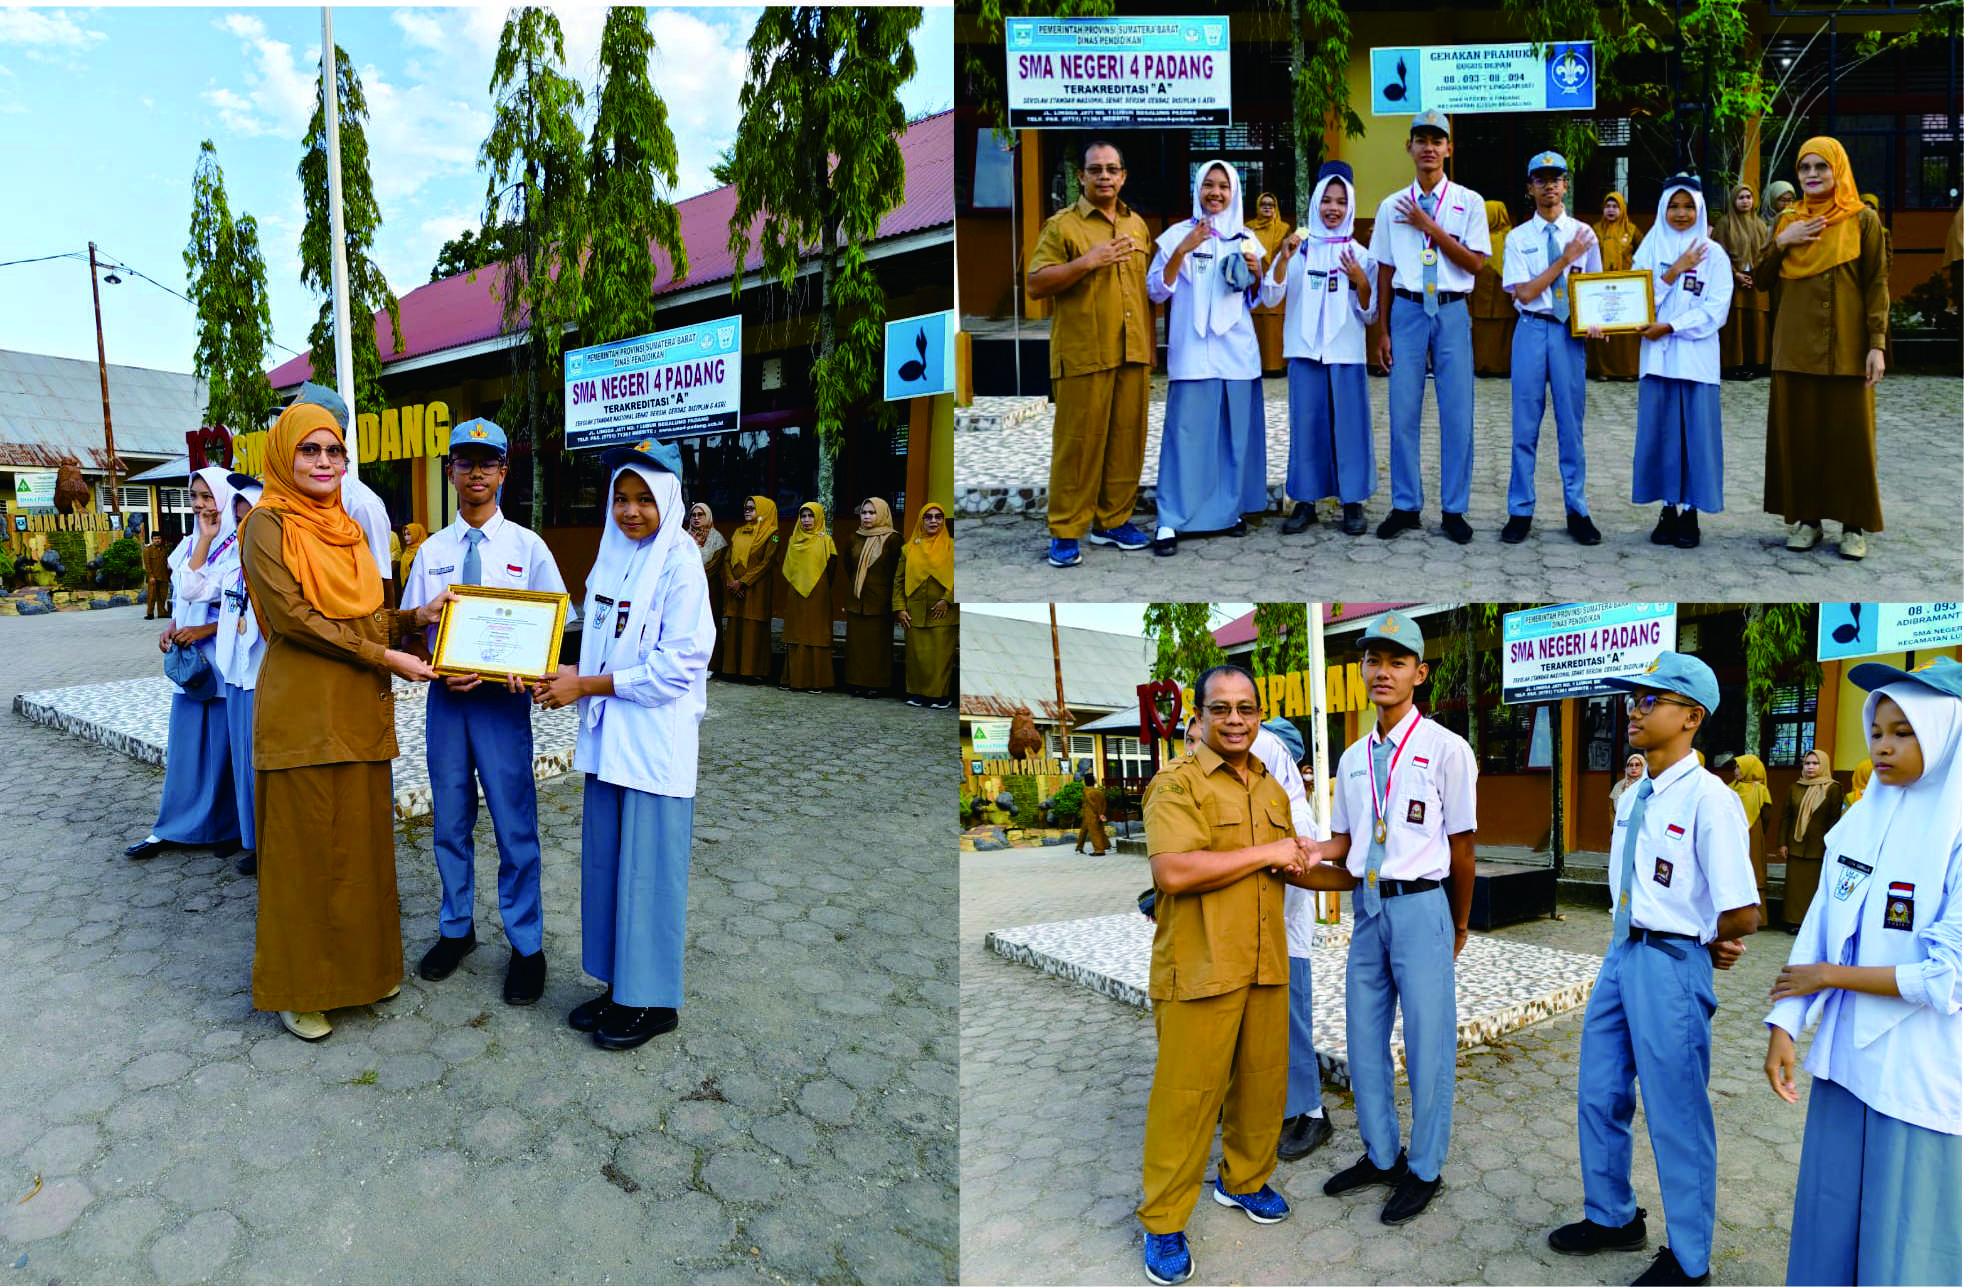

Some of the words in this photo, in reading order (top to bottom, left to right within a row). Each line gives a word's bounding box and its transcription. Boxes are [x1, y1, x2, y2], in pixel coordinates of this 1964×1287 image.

[1077, 36, 1098, 45] DINAS
[1430, 51, 1481, 61] GERAKAN
[1019, 55, 1054, 79] SMA
[1061, 54, 1124, 79] NEGERI
[1130, 54, 1140, 79] 4
[1145, 54, 1213, 80] PADANG
[1063, 84, 1149, 94] TERAKREDITASI
[1152, 82, 1173, 94] "A"
[588, 349, 619, 361] PEMERINTAH
[620, 343, 645, 355] PROVINSI
[646, 336, 675, 351] SUMATERA
[677, 333, 697, 345] BARAT
[614, 357, 630, 368] DINAS
[631, 350, 665, 364] PENDIDIKAN
[572, 379, 598, 405] SMA
[601, 371, 649, 401] NEGERI
[654, 369, 662, 393] 4
[665, 358, 725, 391] PADANG
[604, 396, 669, 414] TERAKREDITASI
[671, 392, 689, 405] "A"
[357, 400, 450, 463] DANG
[27, 514, 57, 532] SMAN
[67, 513, 110, 531] PADANG
[1908, 606, 1922, 616] 08
[1934, 603, 1956, 612] 093
[1510, 640, 1535, 664] SMA
[1539, 632, 1586, 659] NEGERI
[1590, 630, 1598, 653] 4
[1602, 621, 1661, 652] PADANG
[1898, 635, 1947, 646] KECAMATAN
[1540, 655, 1605, 672] TERAKREDITASI
[1607, 652, 1625, 664] "A"
[1269, 662, 1372, 721] PAAN
[983, 759, 1012, 776] SMAN
[1021, 758, 1061, 775] PADANG
